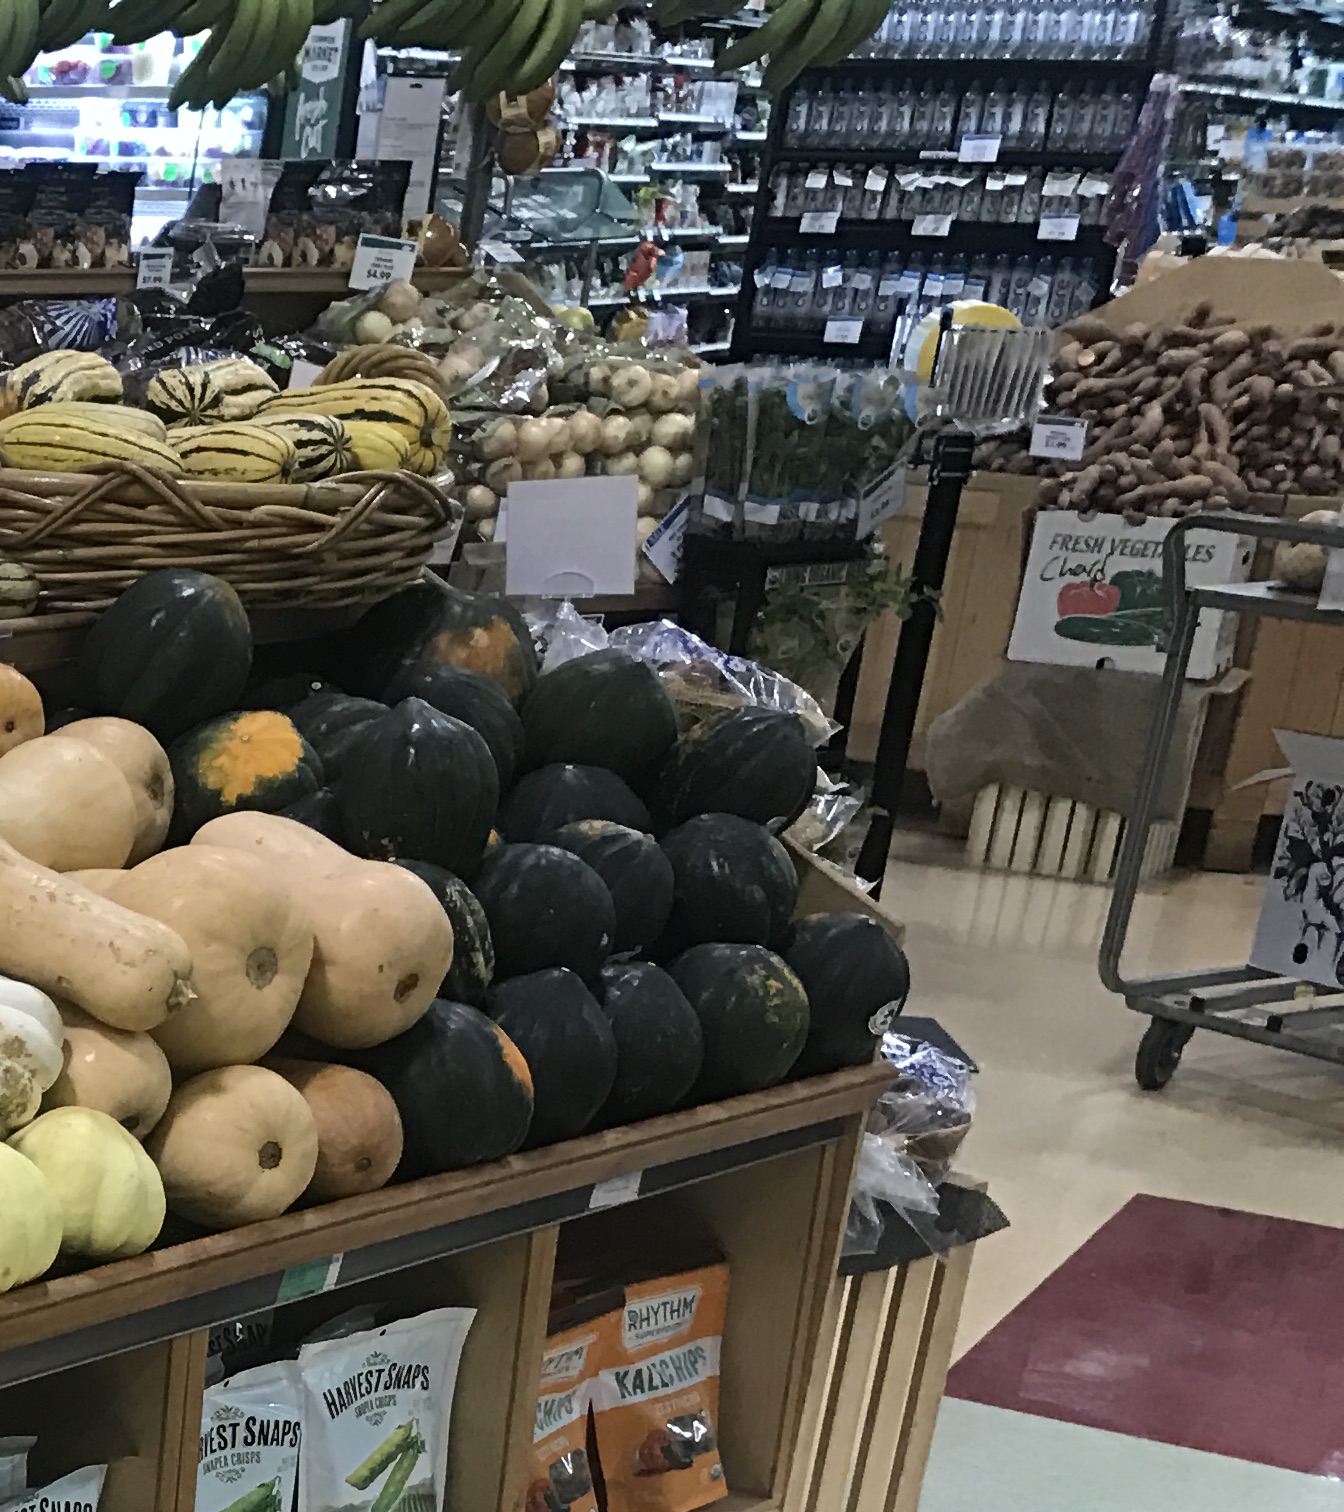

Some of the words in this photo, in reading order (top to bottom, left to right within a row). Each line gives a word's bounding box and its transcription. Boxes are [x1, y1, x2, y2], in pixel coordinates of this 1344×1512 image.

[1049, 533, 1106, 555] FRESH
[1109, 537, 1215, 563] VEGETLES
[627, 1295, 696, 1332] RHYTHM
[323, 1368, 385, 1420] HARVEST
[383, 1362, 430, 1392] SNAPS
[243, 1415, 301, 1449] SNAPS
